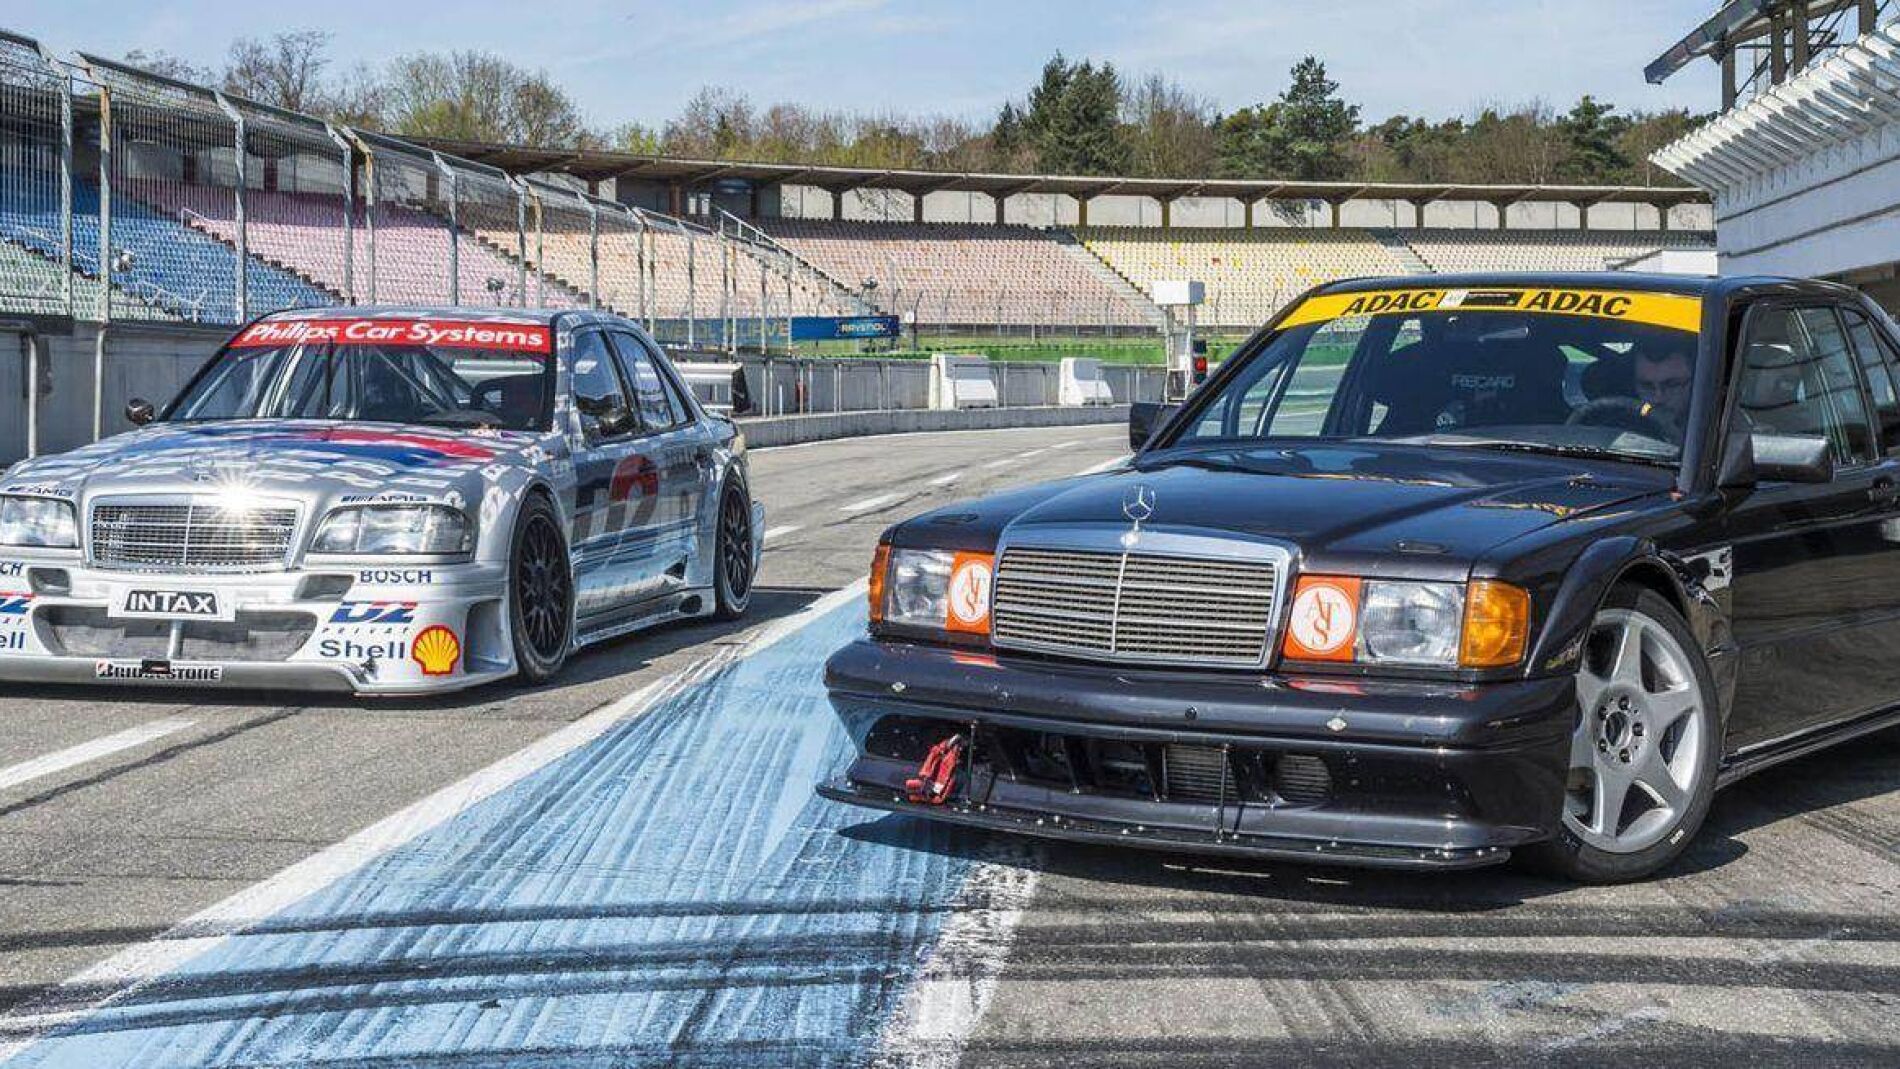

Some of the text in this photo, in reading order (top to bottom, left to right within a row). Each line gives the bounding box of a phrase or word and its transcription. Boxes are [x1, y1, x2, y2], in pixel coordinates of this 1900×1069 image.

[1340, 291, 1436, 316] ADAC
[1526, 291, 1632, 316] ADAC
[242, 321, 543, 345] Philips Car Systems
[360, 570, 432, 584] BOSCH
[129, 591, 214, 614] INTAX
[319, 639, 406, 660] Shell
